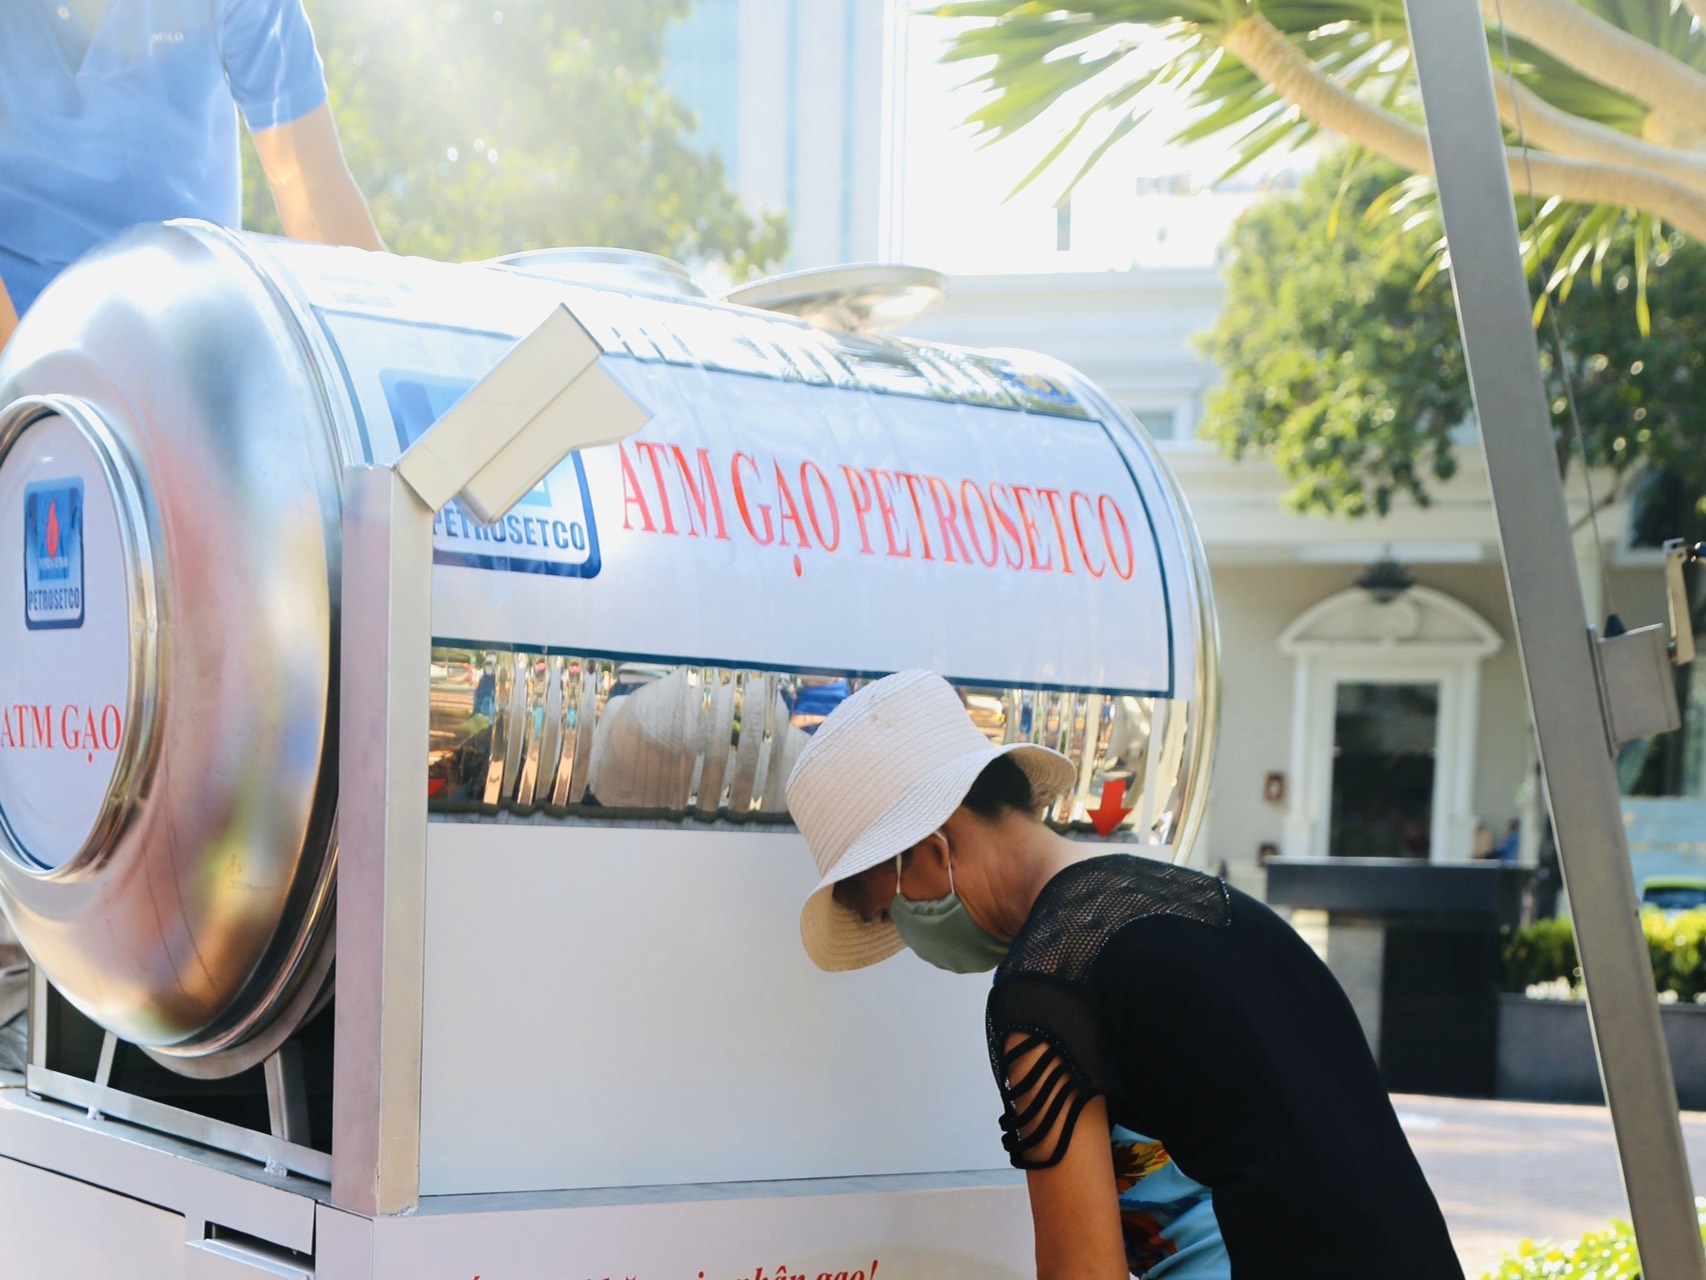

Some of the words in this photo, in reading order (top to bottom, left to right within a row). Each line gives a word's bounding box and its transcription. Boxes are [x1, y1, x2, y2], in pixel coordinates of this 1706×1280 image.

[619, 440, 730, 541] ATM
[731, 451, 840, 577] GẠO
[839, 464, 1134, 581] PETROSETCO
[28, 586, 80, 610] PETROSETCO
[0, 704, 53, 749] ATM
[60, 704, 122, 764] GẠO
